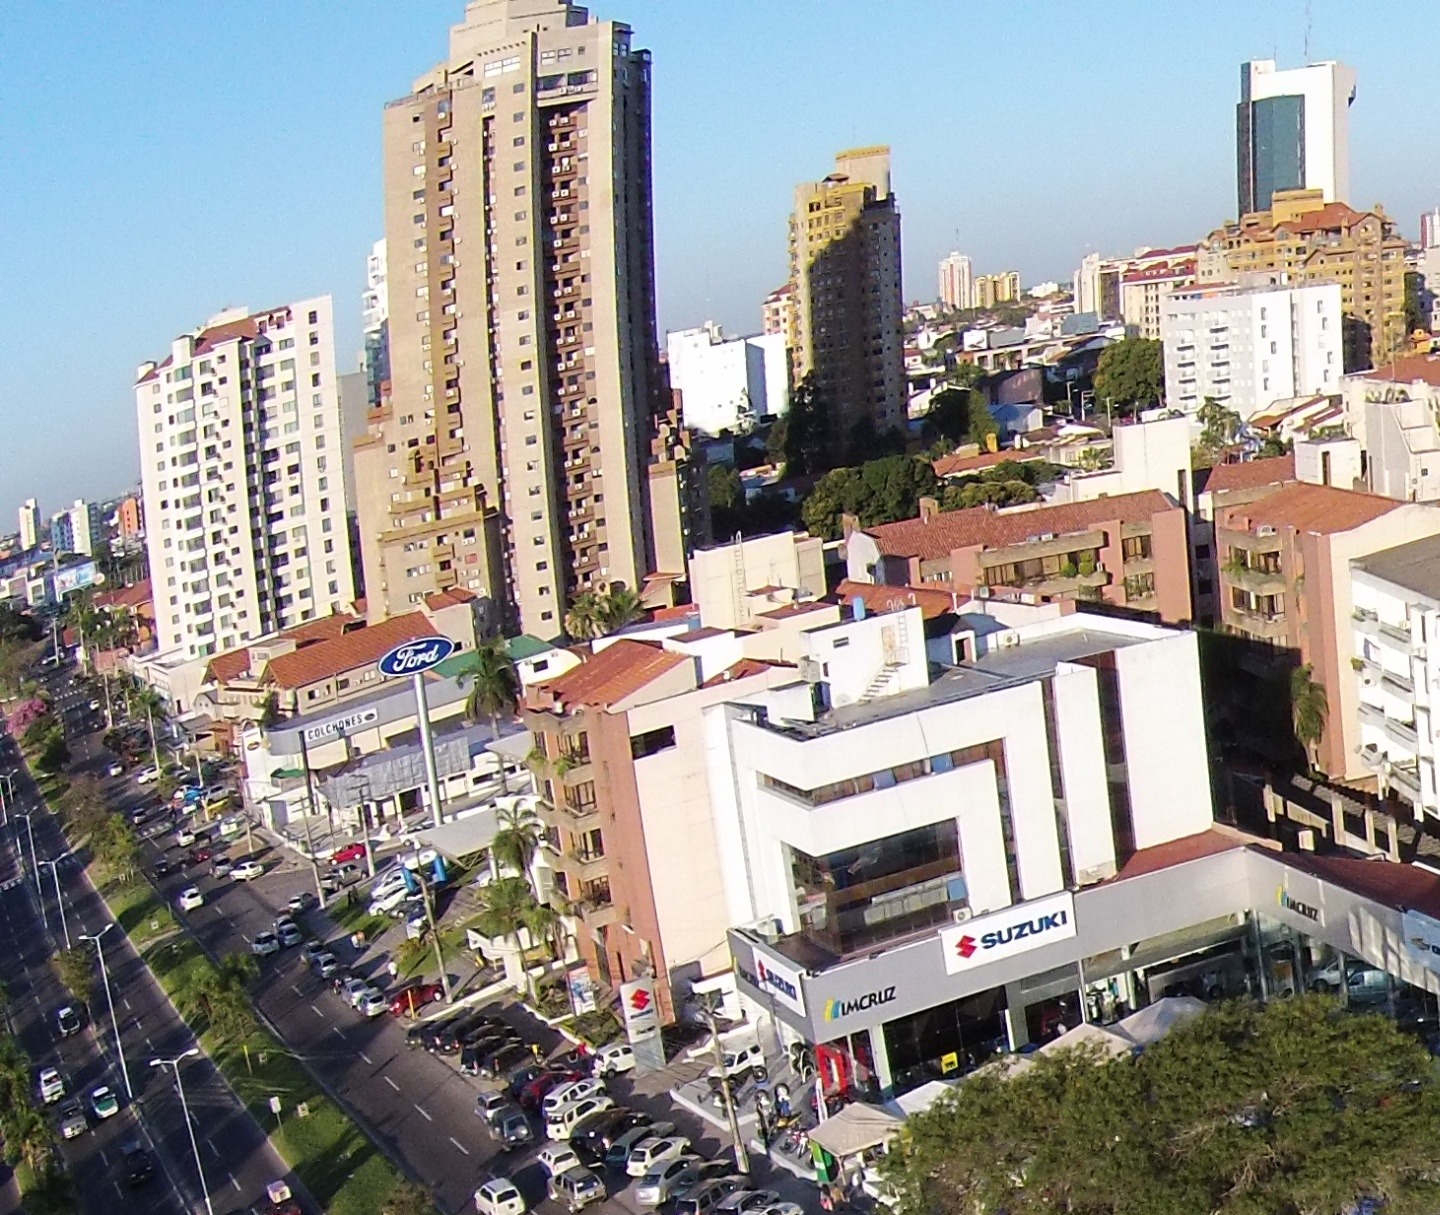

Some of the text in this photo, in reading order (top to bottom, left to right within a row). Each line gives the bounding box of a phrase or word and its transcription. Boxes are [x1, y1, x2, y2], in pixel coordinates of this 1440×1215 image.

[393, 643, 439, 672] Ford
[308, 714, 363, 740] COLCHONES
[981, 910, 1068, 950] SUZUKI
[841, 986, 897, 1016] IMCRUZ
